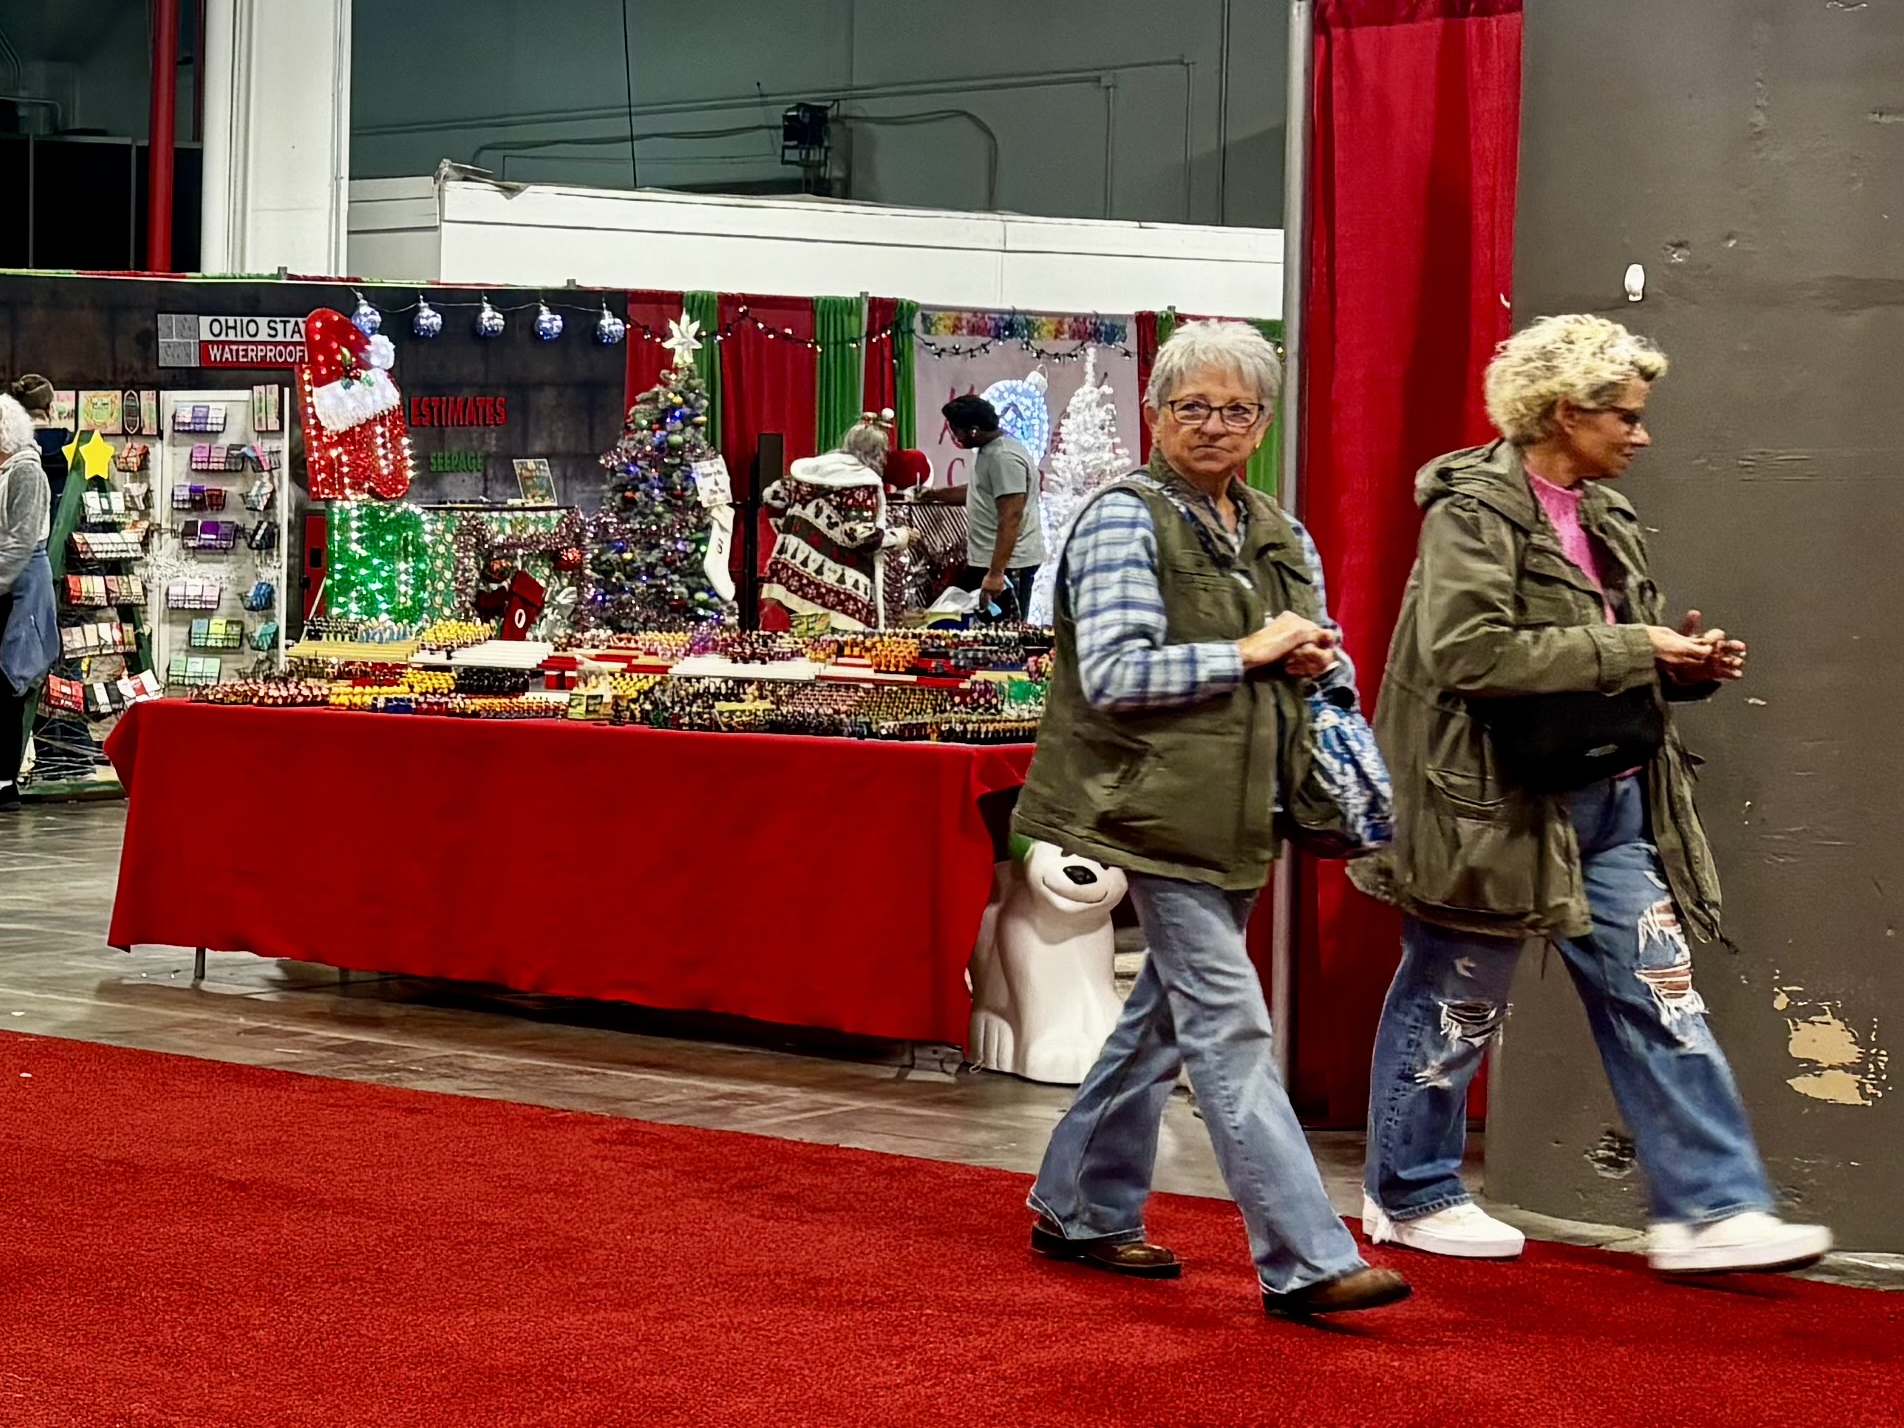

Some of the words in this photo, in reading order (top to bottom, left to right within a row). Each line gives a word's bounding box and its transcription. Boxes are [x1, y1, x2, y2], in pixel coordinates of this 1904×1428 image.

[209, 318, 259, 338] OHIO
[267, 319, 306, 339] STA
[410, 396, 508, 427] ESTIMATES
[430, 451, 484, 473] SEEPAGE
